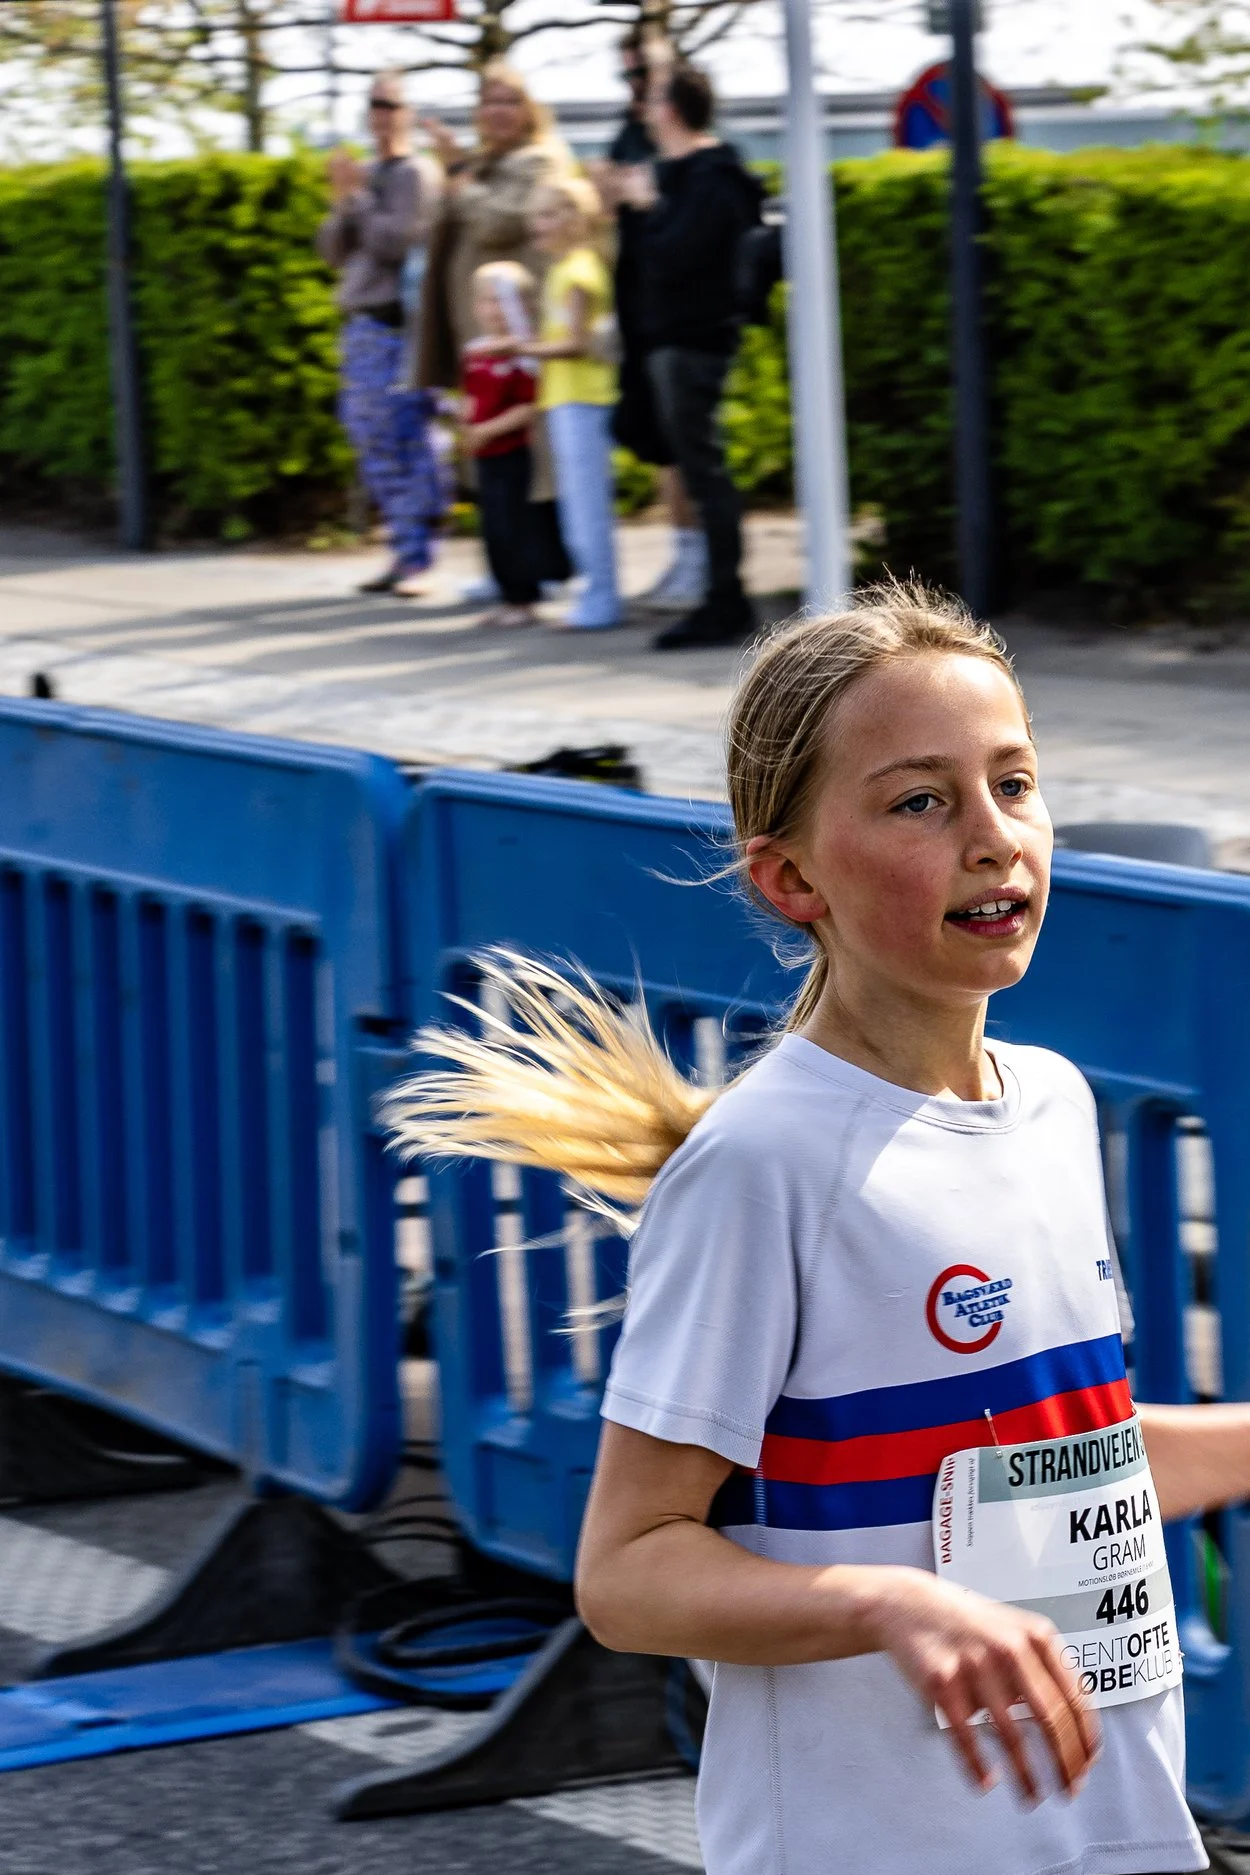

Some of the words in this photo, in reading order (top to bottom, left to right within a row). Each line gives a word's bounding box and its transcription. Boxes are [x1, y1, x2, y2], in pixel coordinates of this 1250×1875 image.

[1008, 1425, 1141, 1487] STRANDVEJEN
[1069, 1489, 1152, 1544] KARLA
[1093, 1534, 1146, 1571] GRAM
[1096, 1578, 1150, 1625] 446
[1059, 1621, 1170, 1671] GENTOFTE
[1076, 1649, 1174, 1696] ØBEKLUB
